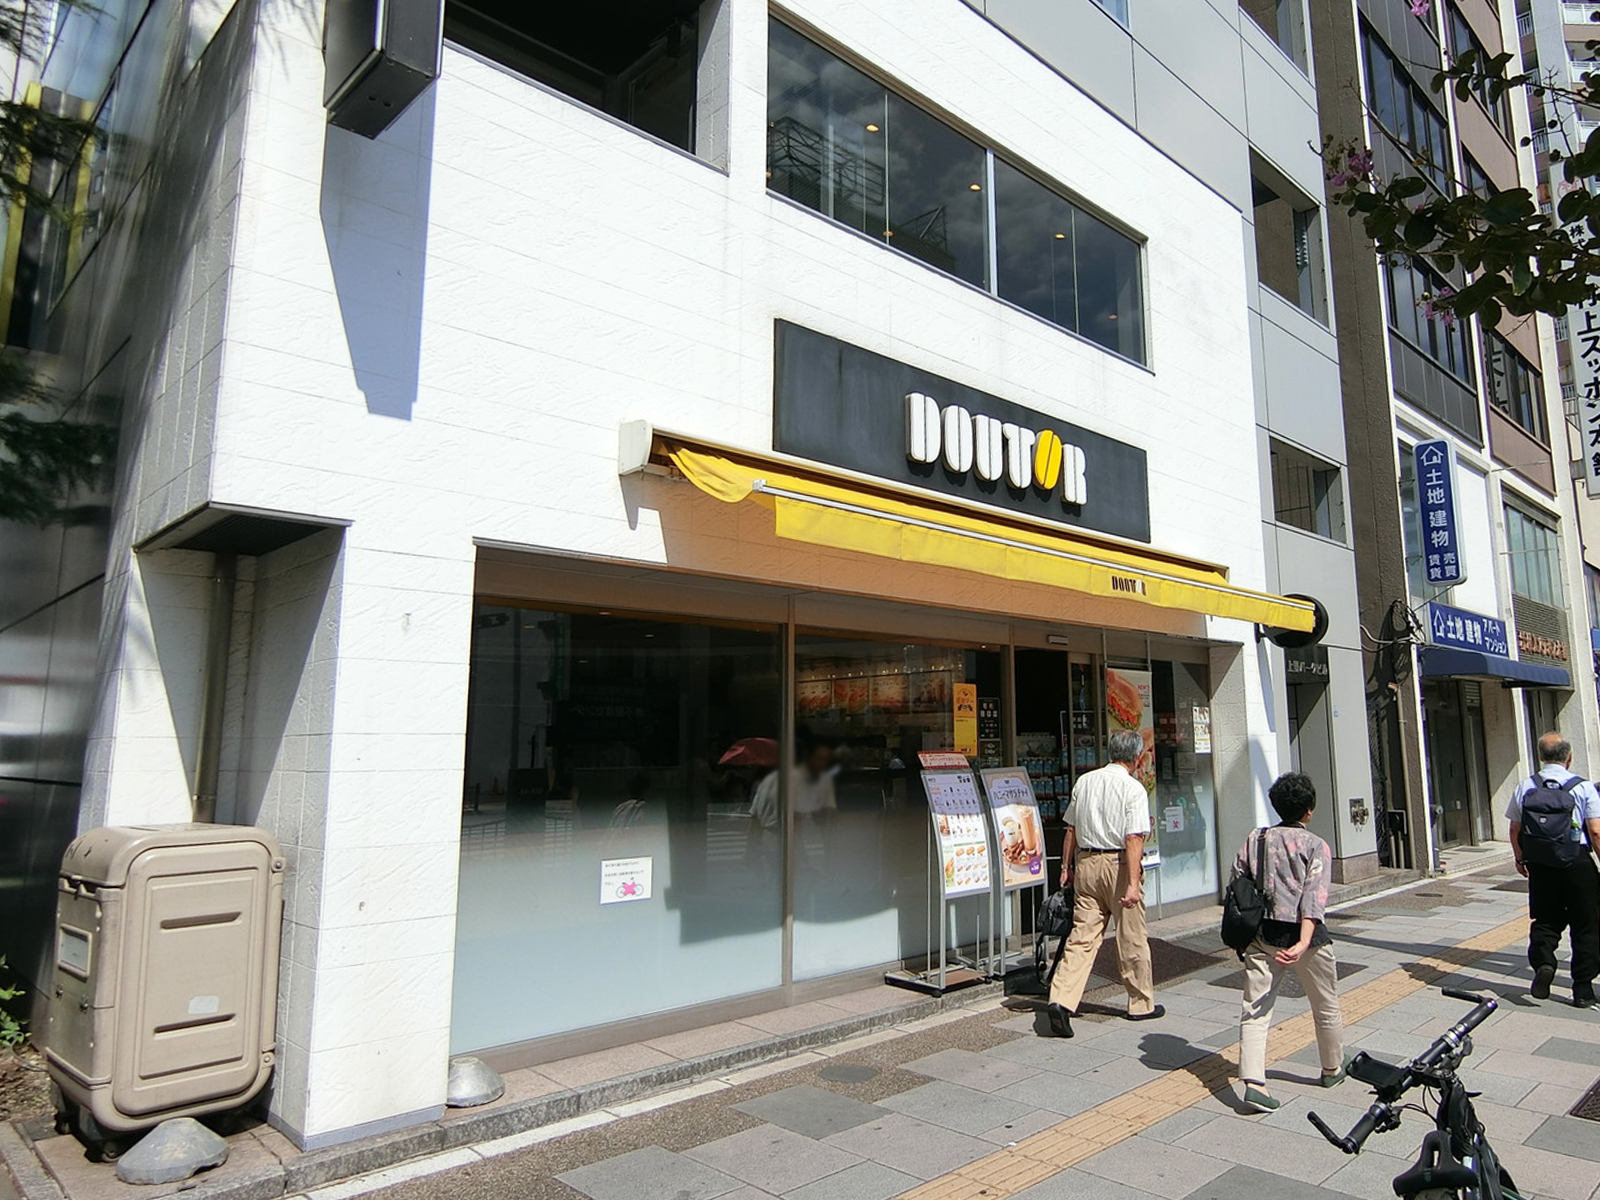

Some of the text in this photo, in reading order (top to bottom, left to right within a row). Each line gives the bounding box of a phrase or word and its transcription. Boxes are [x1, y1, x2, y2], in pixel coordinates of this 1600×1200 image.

[905, 392, 1087, 505] DOUTOR
[1426, 469, 1449, 548] 土地建物
[1443, 553, 1457, 577] 売買
[1446, 615, 1483, 646] 土地建物
[1482, 618, 1501, 637] アパート
[1484, 636, 1507, 654] マンション
